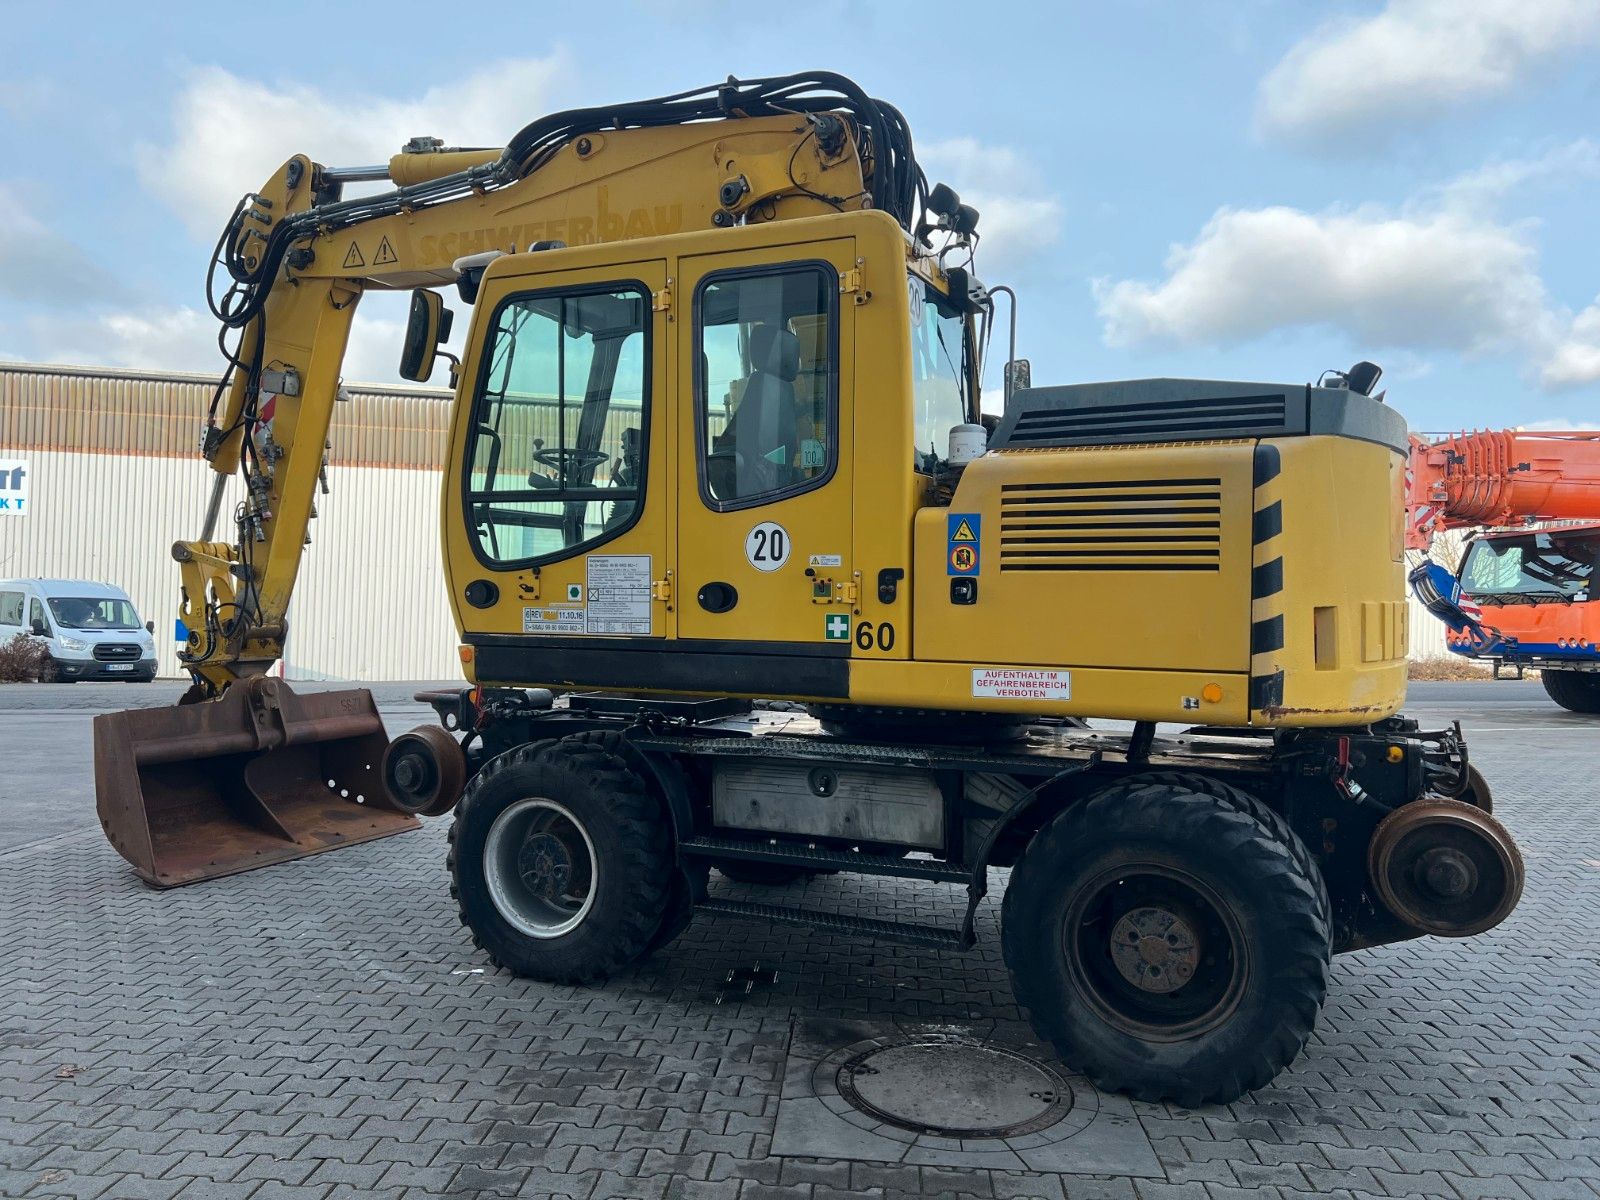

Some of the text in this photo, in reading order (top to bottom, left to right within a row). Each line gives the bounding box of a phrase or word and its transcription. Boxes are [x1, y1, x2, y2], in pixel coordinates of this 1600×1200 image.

[753, 529, 784, 561] 20
[559, 611, 583, 620] 11.10.16
[855, 621, 895, 651] 60
[985, 671, 1057, 680] AUFENTHALT IM
[976, 679, 1067, 689] GEFAHRENBEREICH
[996, 689, 1046, 698] VERBOTEN
